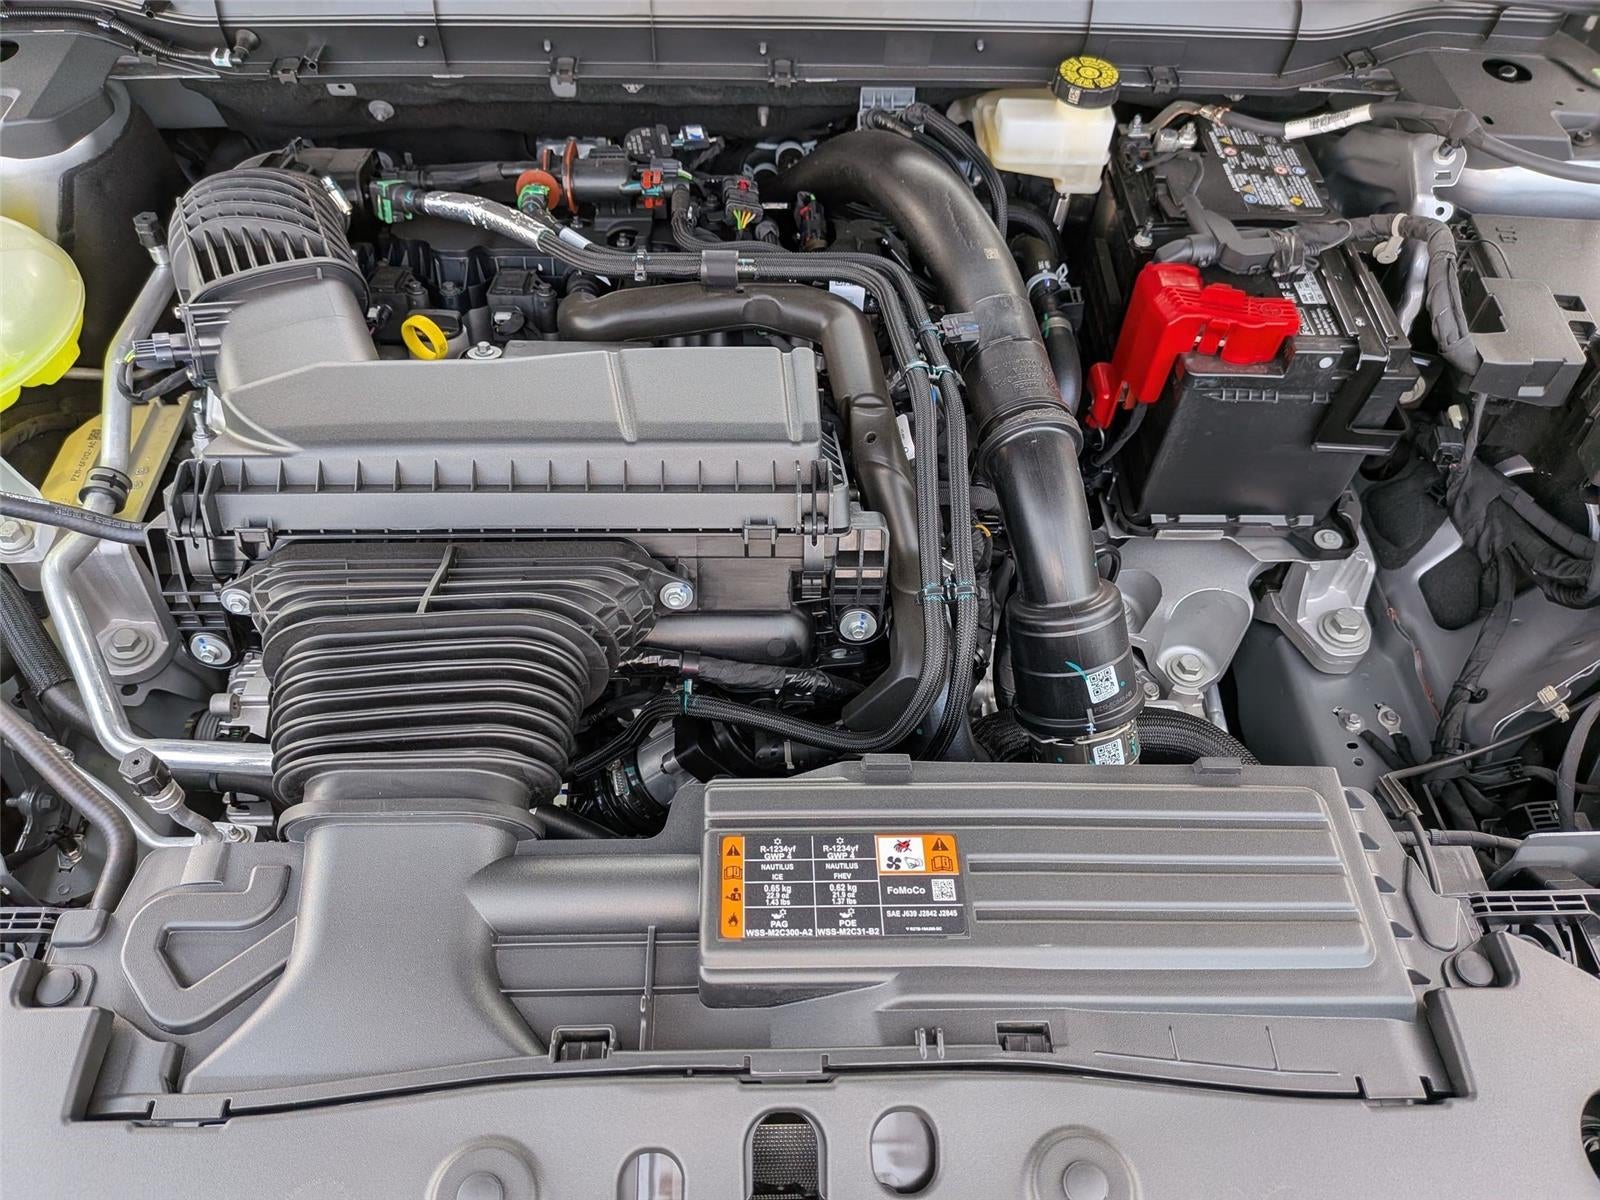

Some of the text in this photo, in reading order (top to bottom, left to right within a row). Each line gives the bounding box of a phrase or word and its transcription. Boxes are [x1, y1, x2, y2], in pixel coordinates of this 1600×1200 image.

[760, 845, 796, 854] R-1234yf
[823, 844, 859, 854] R-1234yf
[849, 851, 855, 859] 4
[781, 885, 792, 894] kg
[847, 884, 857, 893] kg
[887, 886, 926, 894] FoMoCo
[770, 920, 788, 928] PAG
[839, 919, 857, 927] POE
[746, 929, 813, 937] WSS-M2C300-A2
[817, 928, 880, 936] WSS-M2C31-B2
